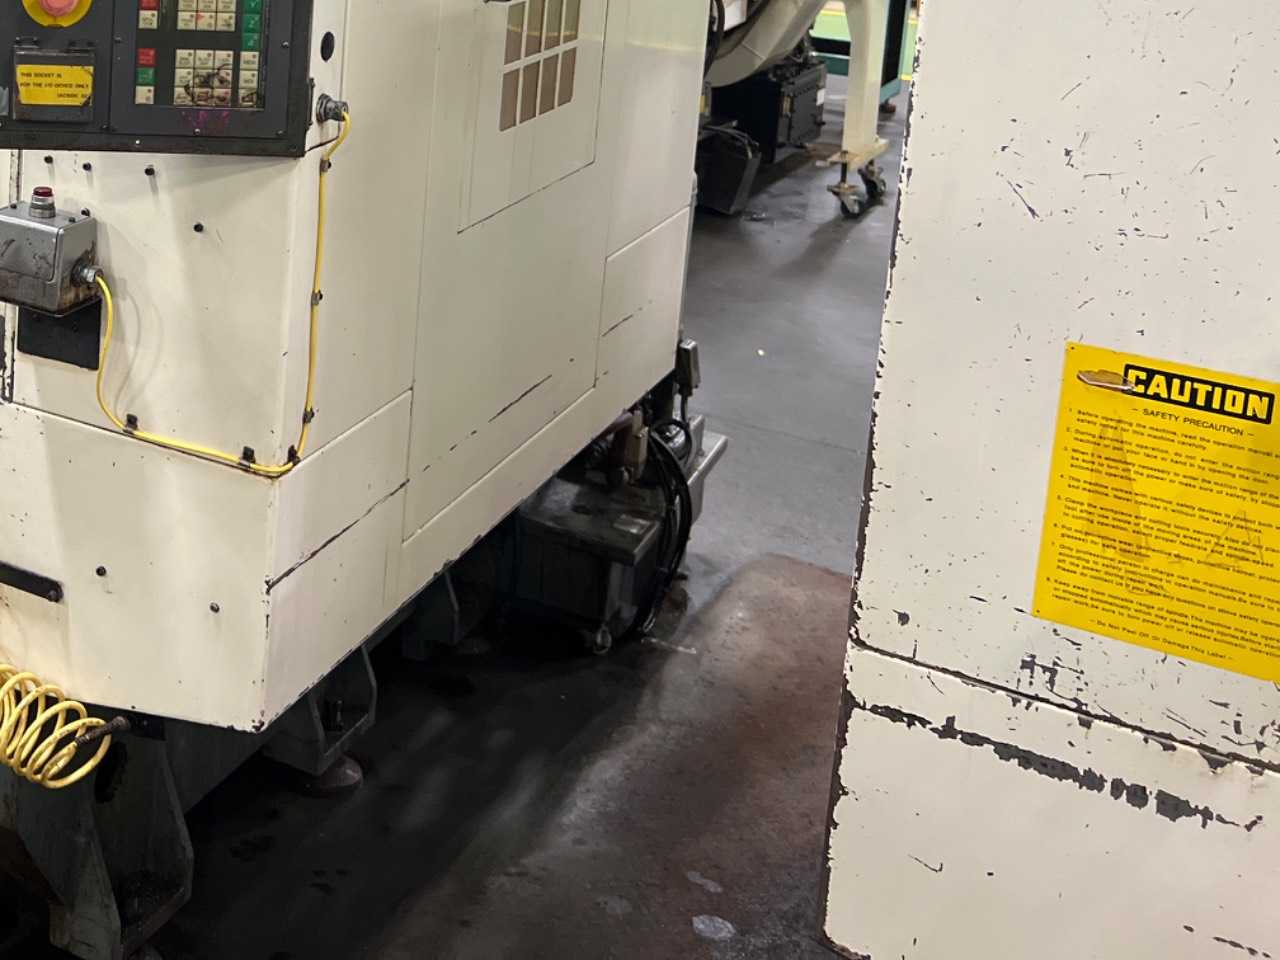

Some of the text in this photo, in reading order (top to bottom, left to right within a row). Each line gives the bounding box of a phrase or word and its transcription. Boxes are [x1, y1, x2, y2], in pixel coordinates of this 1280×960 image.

[1127, 368, 1270, 420] CAUTION
[1142, 408, 1243, 436] SAFETY PRECAUTION
